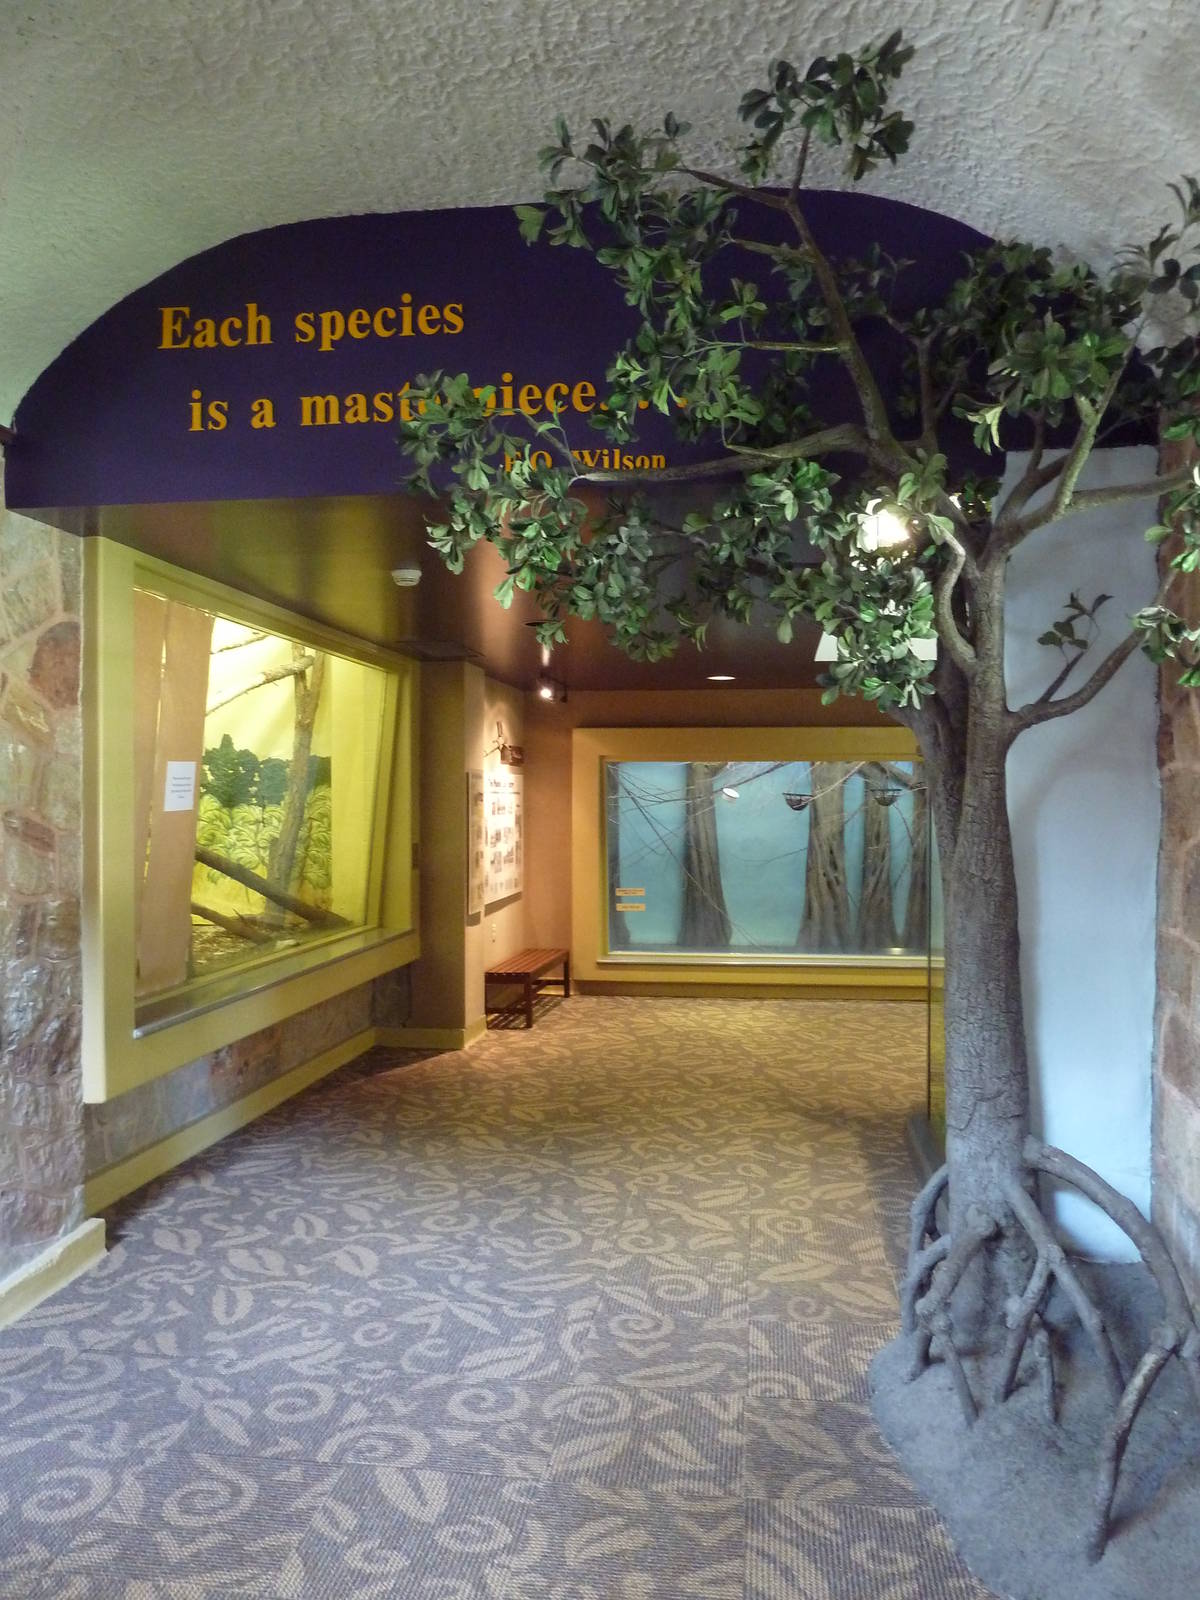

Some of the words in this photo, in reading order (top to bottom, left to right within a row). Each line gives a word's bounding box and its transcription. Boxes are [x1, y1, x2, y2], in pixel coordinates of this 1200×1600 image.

[157, 303, 273, 349] Each
[295, 293, 464, 351] species
[189, 389, 229, 431] is
[251, 397, 276, 429] a
[570, 449, 666, 470] Wilson
